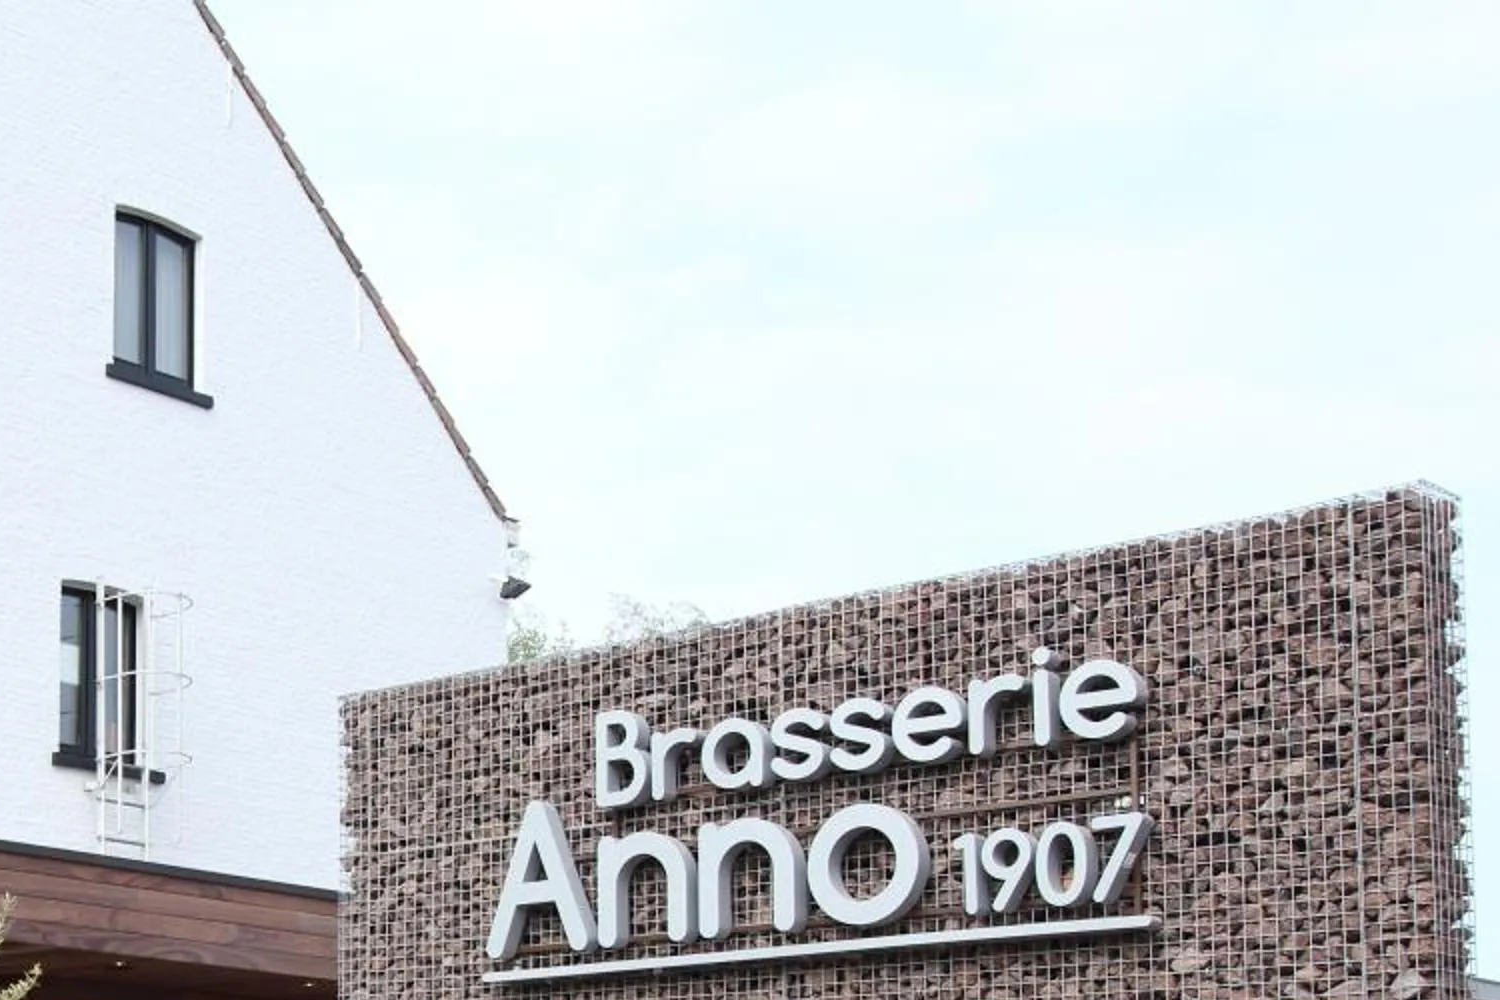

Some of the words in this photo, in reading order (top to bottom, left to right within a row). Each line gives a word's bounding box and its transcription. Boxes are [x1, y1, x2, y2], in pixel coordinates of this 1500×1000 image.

[595, 648, 1150, 809] Brasserie
[486, 800, 932, 960] Anno
[952, 811, 1156, 916] 1907
